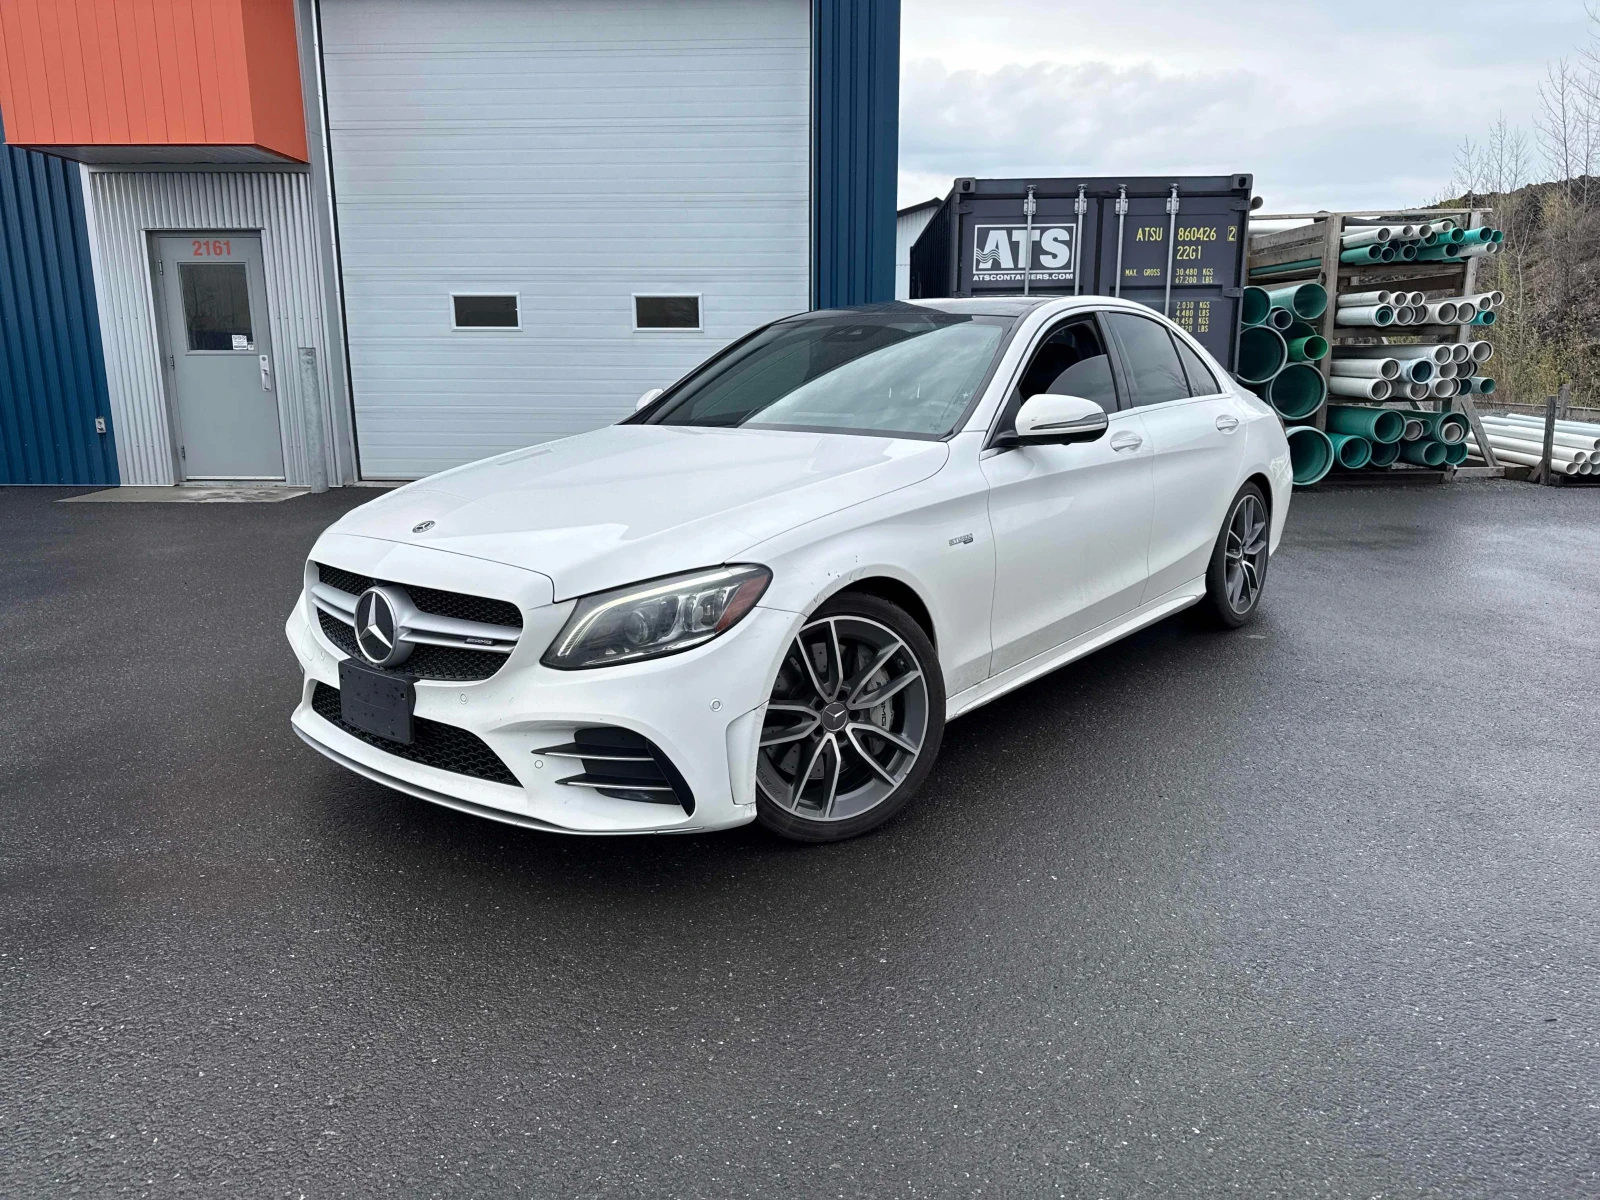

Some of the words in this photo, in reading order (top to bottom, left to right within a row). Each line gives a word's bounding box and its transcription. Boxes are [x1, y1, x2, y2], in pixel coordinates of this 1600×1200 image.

[1136, 227, 1163, 241] ATSU
[1177, 227, 1217, 241] 860426
[1228, 226, 1237, 241] 2
[192, 239, 231, 257] 2161
[978, 228, 1070, 269] ATS
[1176, 246, 1202, 260] 22G1
[1176, 268, 1198, 276] 30.480
[1202, 268, 1214, 276] KGS
[973, 273, 1074, 281] ATSCONTAIERS.COM
[1175, 276, 1197, 284] 67.200
[1202, 276, 1213, 284] LBS
[1176, 301, 1195, 309] 2.030
[1199, 301, 1211, 309] KGS
[1175, 309, 1194, 317] 4.480
[1198, 309, 1210, 317] LBS
[1198, 317, 1210, 325] KGS
[1197, 325, 1209, 333] LBS
